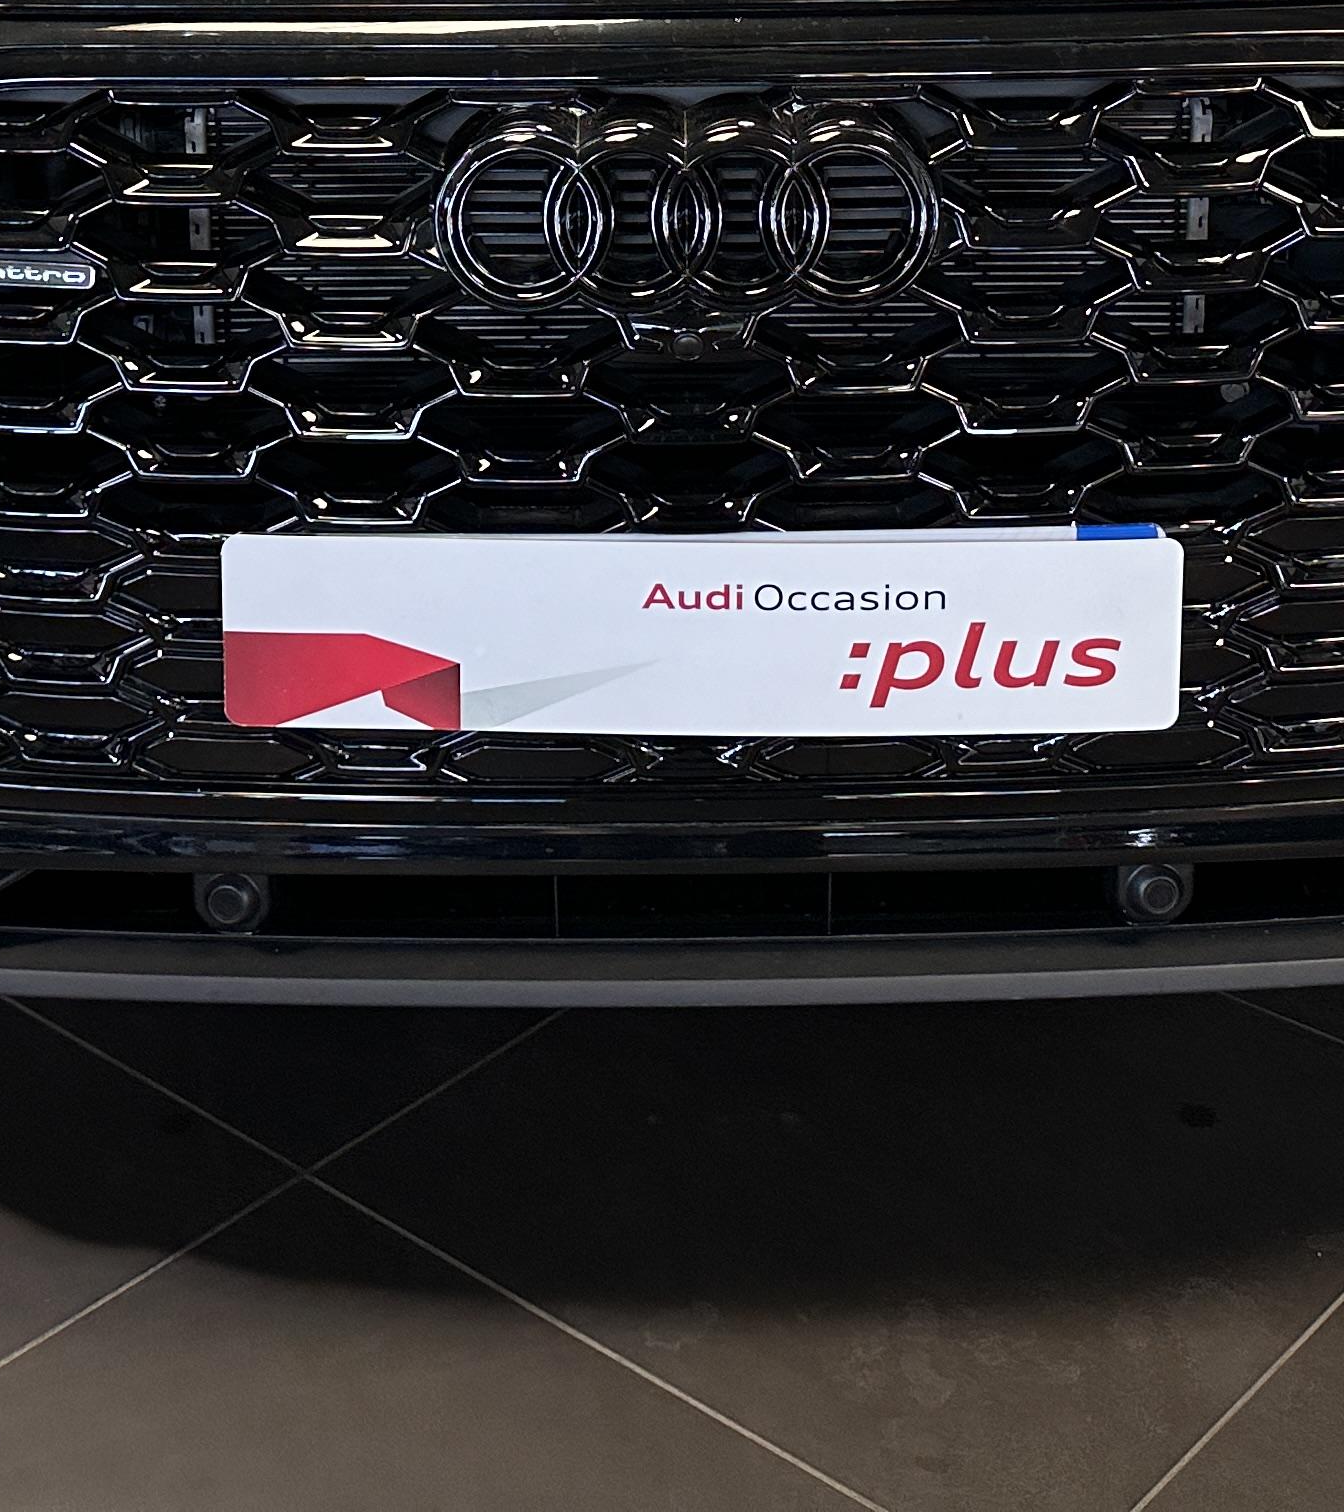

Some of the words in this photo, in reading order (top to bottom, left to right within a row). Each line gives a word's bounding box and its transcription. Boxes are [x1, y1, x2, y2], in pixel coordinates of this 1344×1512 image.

[642, 583, 744, 611] Audi
[753, 583, 947, 611] Occasion
[839, 621, 1123, 709] :plus
